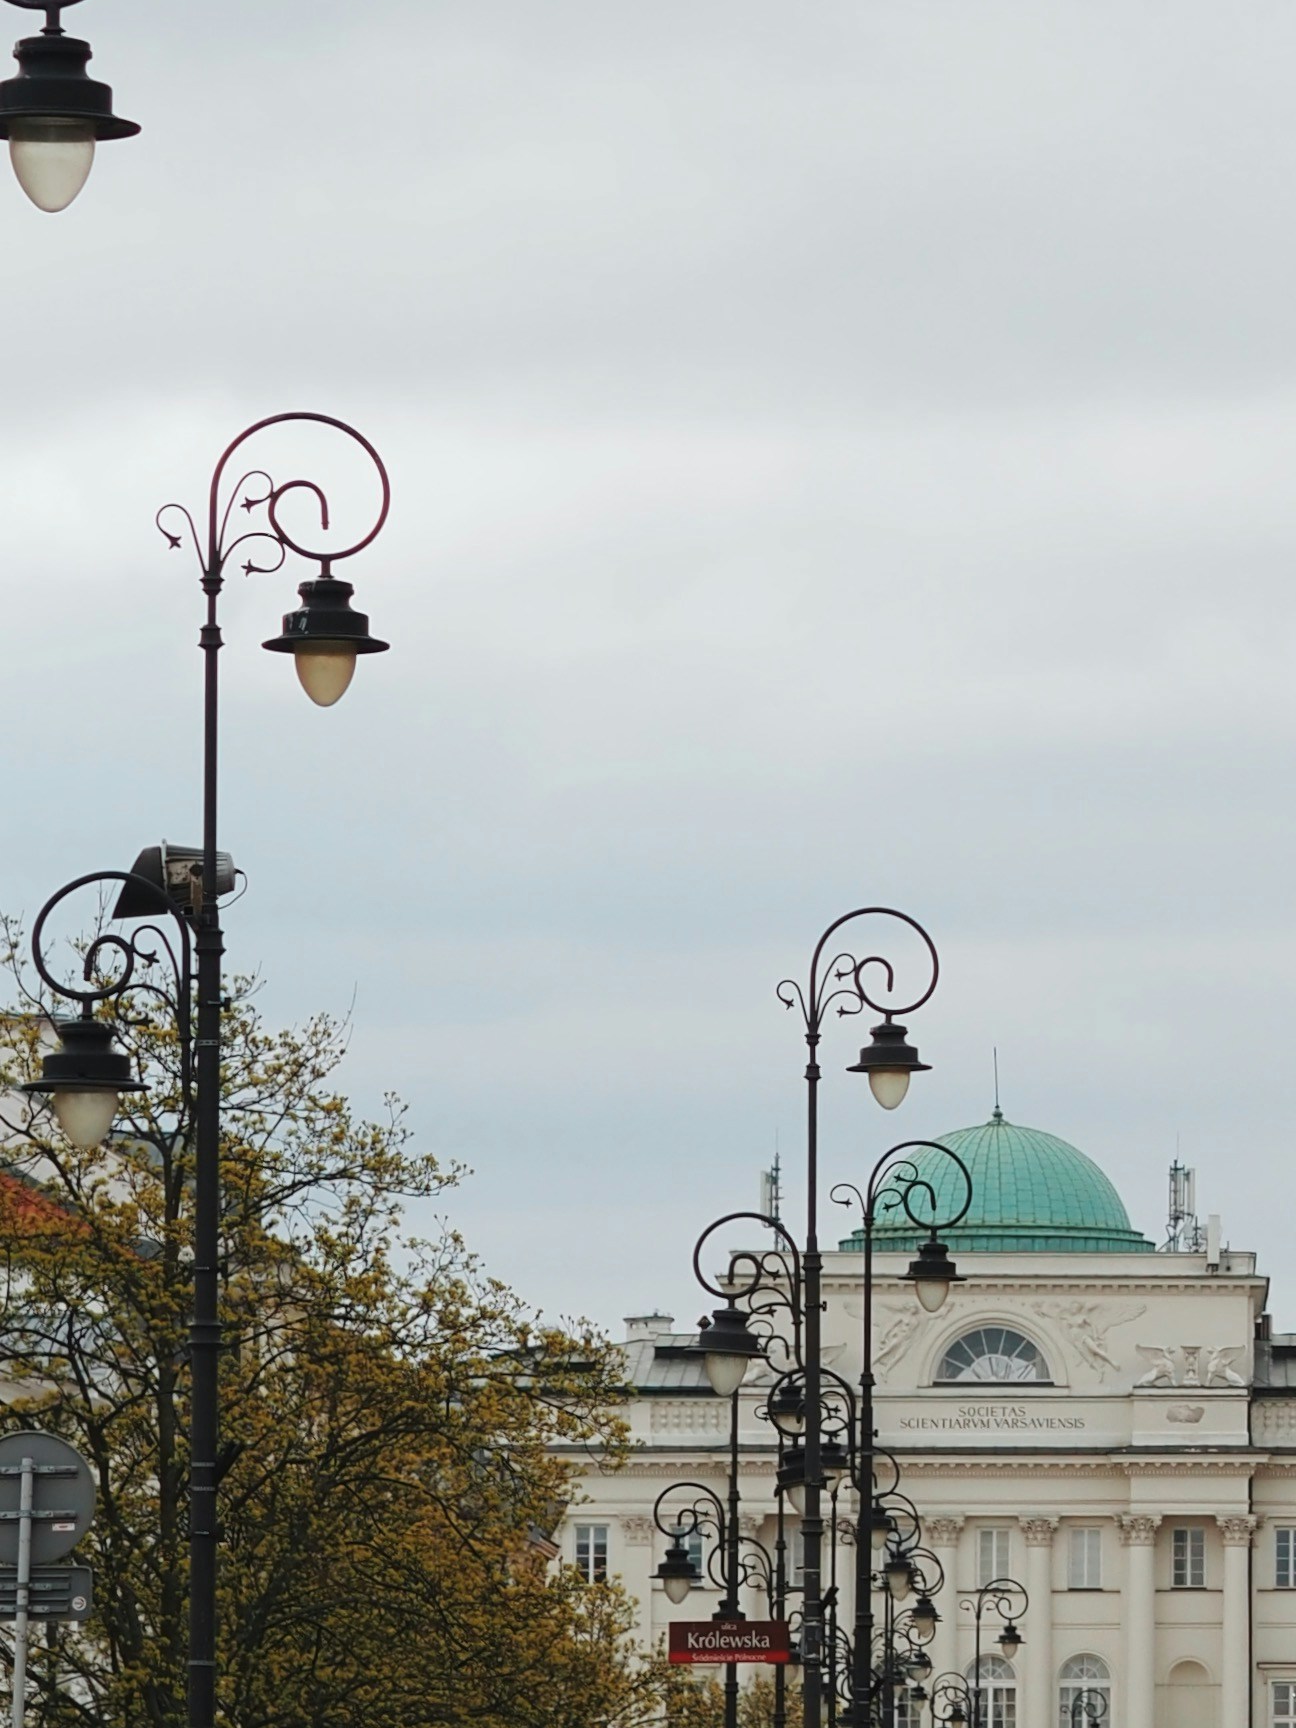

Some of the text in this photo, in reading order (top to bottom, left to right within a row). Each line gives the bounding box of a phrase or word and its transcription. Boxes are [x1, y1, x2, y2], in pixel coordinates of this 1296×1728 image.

[958, 1406, 1026, 1417] SOCIETAS
[900, 1418, 1085, 1429] SCIENTIARVM VARSAVIENSIS
[720, 1622, 737, 1630] ulica
[687, 1630, 770, 1649] Królewska
